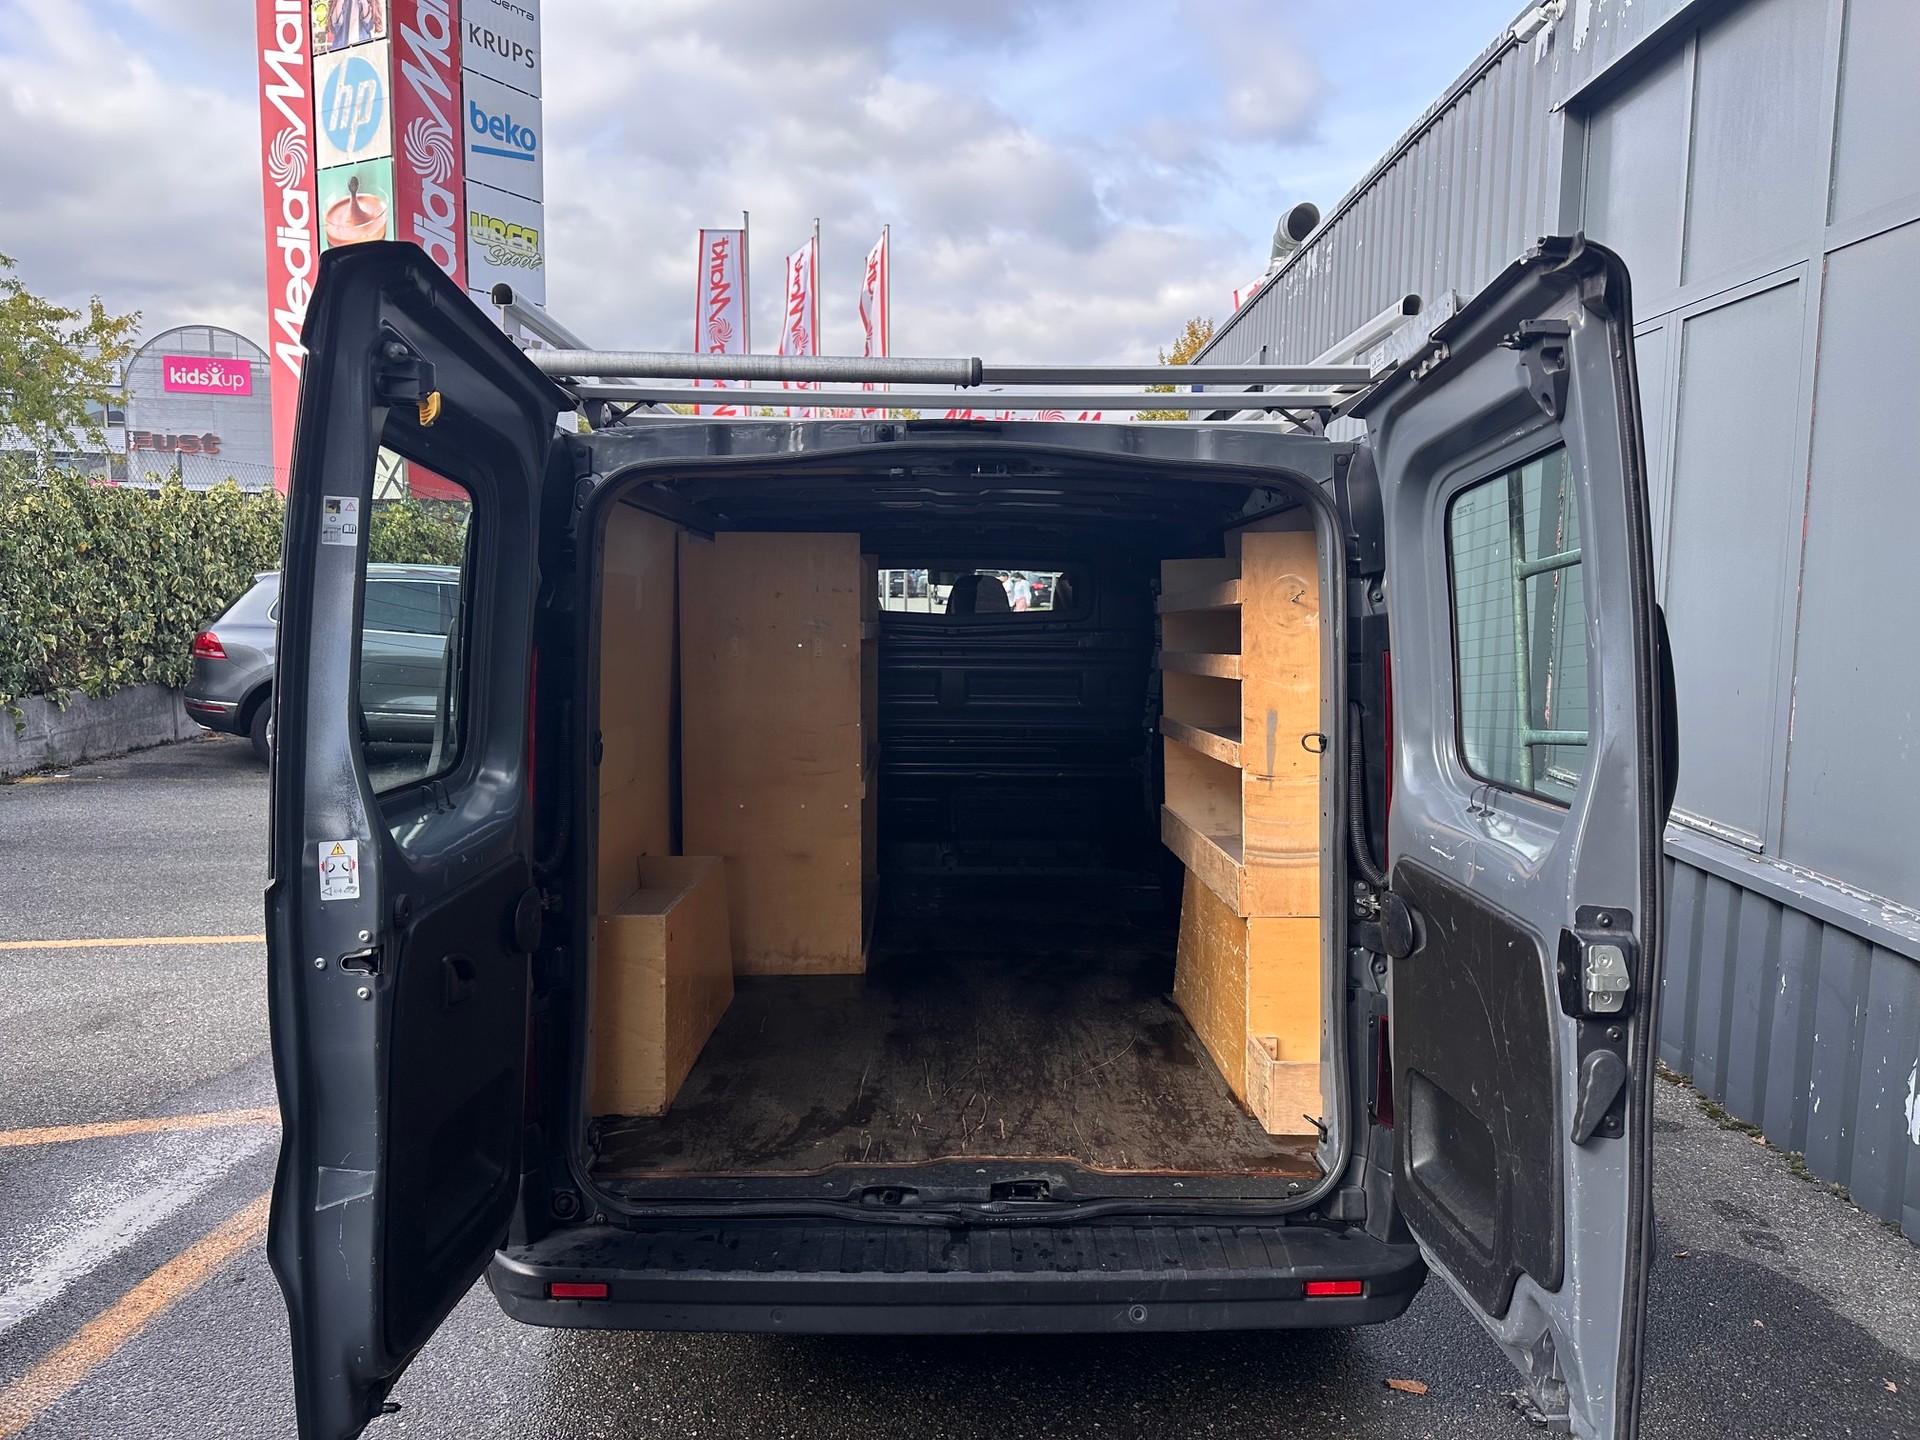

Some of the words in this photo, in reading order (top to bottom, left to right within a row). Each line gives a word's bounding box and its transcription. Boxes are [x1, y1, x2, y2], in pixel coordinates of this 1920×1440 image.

[469, 22, 535, 69] KRUPS
[328, 56, 377, 155] hp
[470, 100, 537, 151] beko
[484, 244, 543, 270] Scoot
[170, 366, 210, 386] kids
[221, 374, 245, 392] up
